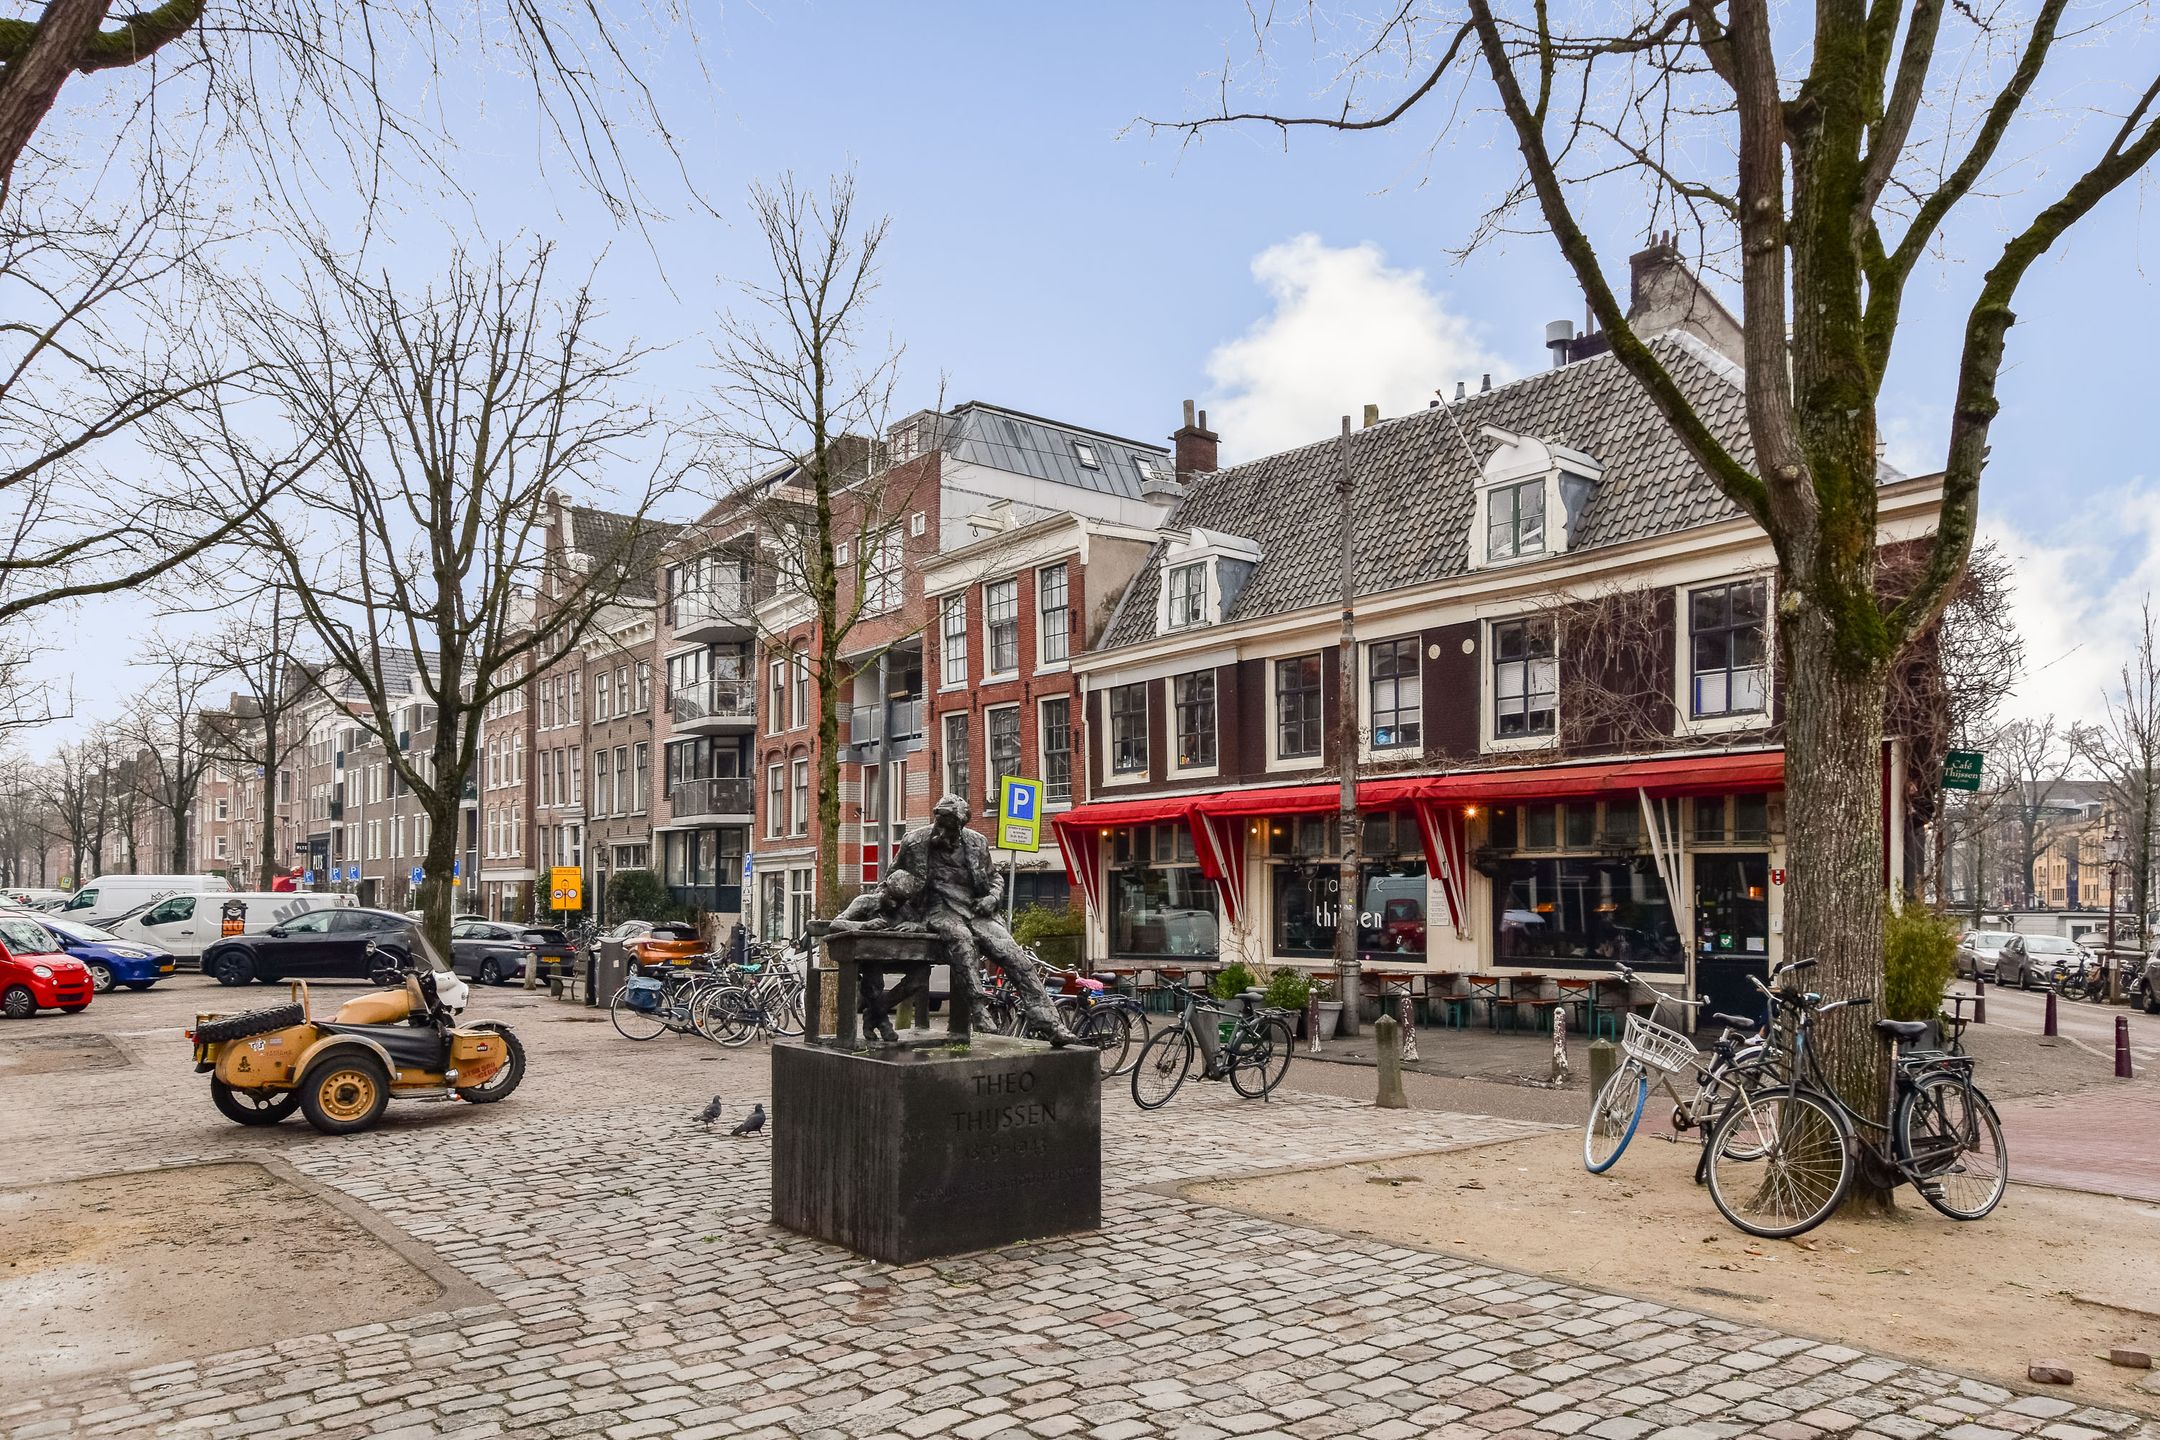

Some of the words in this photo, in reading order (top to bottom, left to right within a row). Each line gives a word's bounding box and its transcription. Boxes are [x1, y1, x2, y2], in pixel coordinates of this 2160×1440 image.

[1943, 766, 1979, 780] Thijssen
[1952, 759, 1973, 769] Café
[1013, 787, 1030, 815] P
[222, 920, 244, 931] NO
[971, 1071, 1036, 1096] THEO
[951, 1102, 1057, 1134] THIJSSEN
